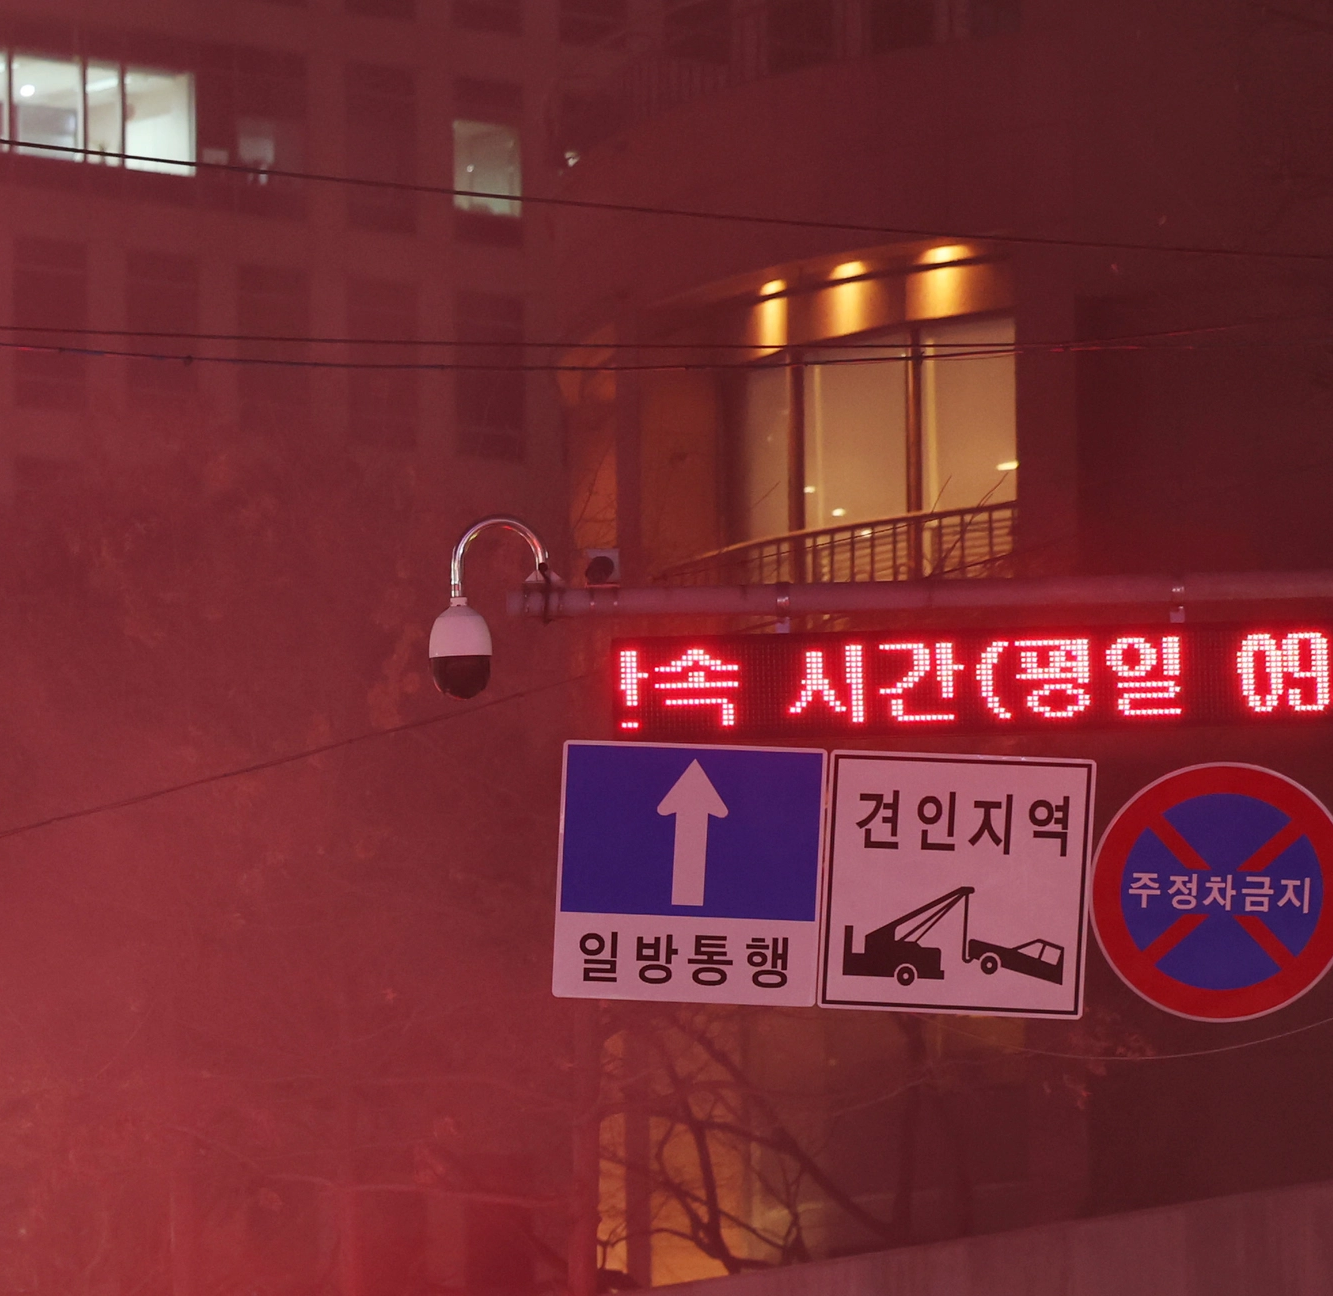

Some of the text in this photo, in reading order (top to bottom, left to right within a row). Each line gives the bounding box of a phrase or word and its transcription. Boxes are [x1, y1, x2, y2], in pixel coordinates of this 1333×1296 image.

[788, 636, 1182, 726] 시간(평일
[855, 788, 1071, 857] 견인지역
[1127, 870, 1312, 915] 주정차금지
[578, 931, 791, 989] 일방통행
